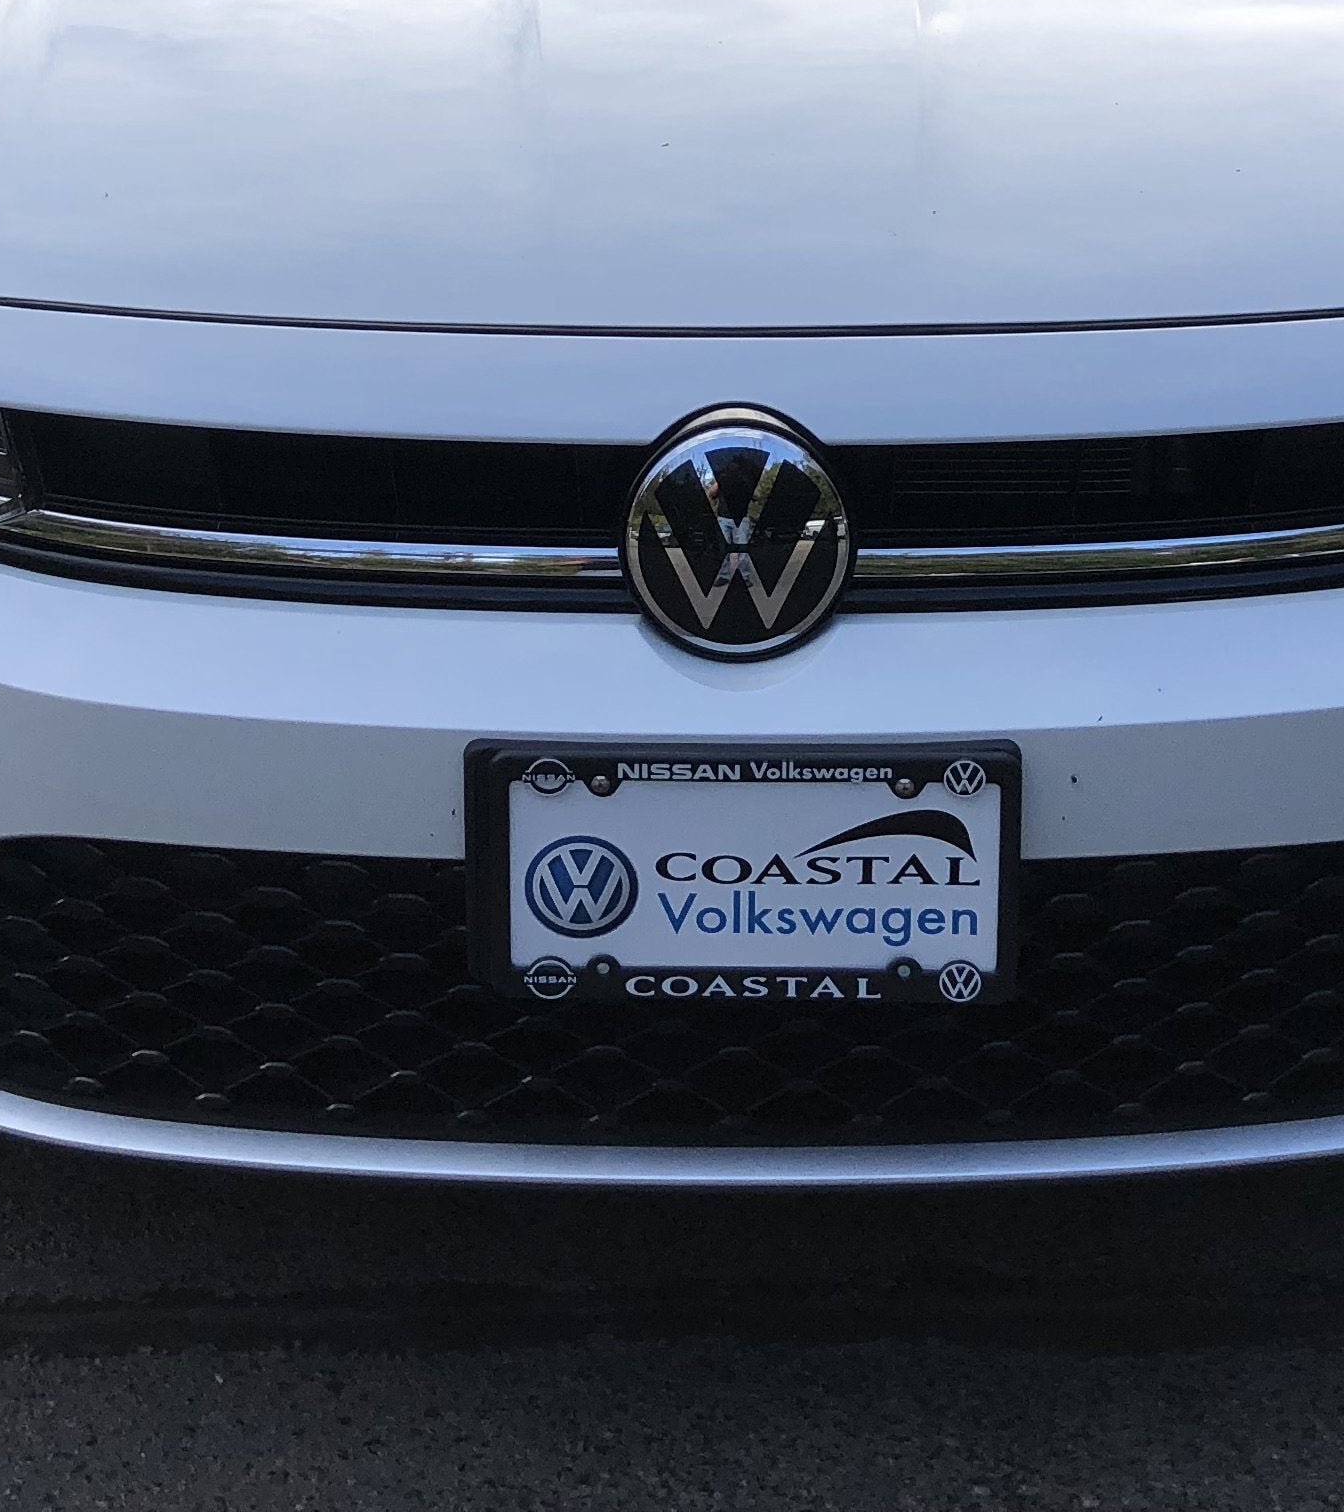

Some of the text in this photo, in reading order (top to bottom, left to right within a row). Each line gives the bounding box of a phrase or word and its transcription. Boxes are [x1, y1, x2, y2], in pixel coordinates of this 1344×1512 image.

[634, 438, 840, 640] VW
[617, 761, 893, 783] NISSAN Volkswagen
[655, 852, 981, 887] COASTAL
[657, 890, 979, 946] Volkswagen
[624, 975, 882, 999] COASTAL
